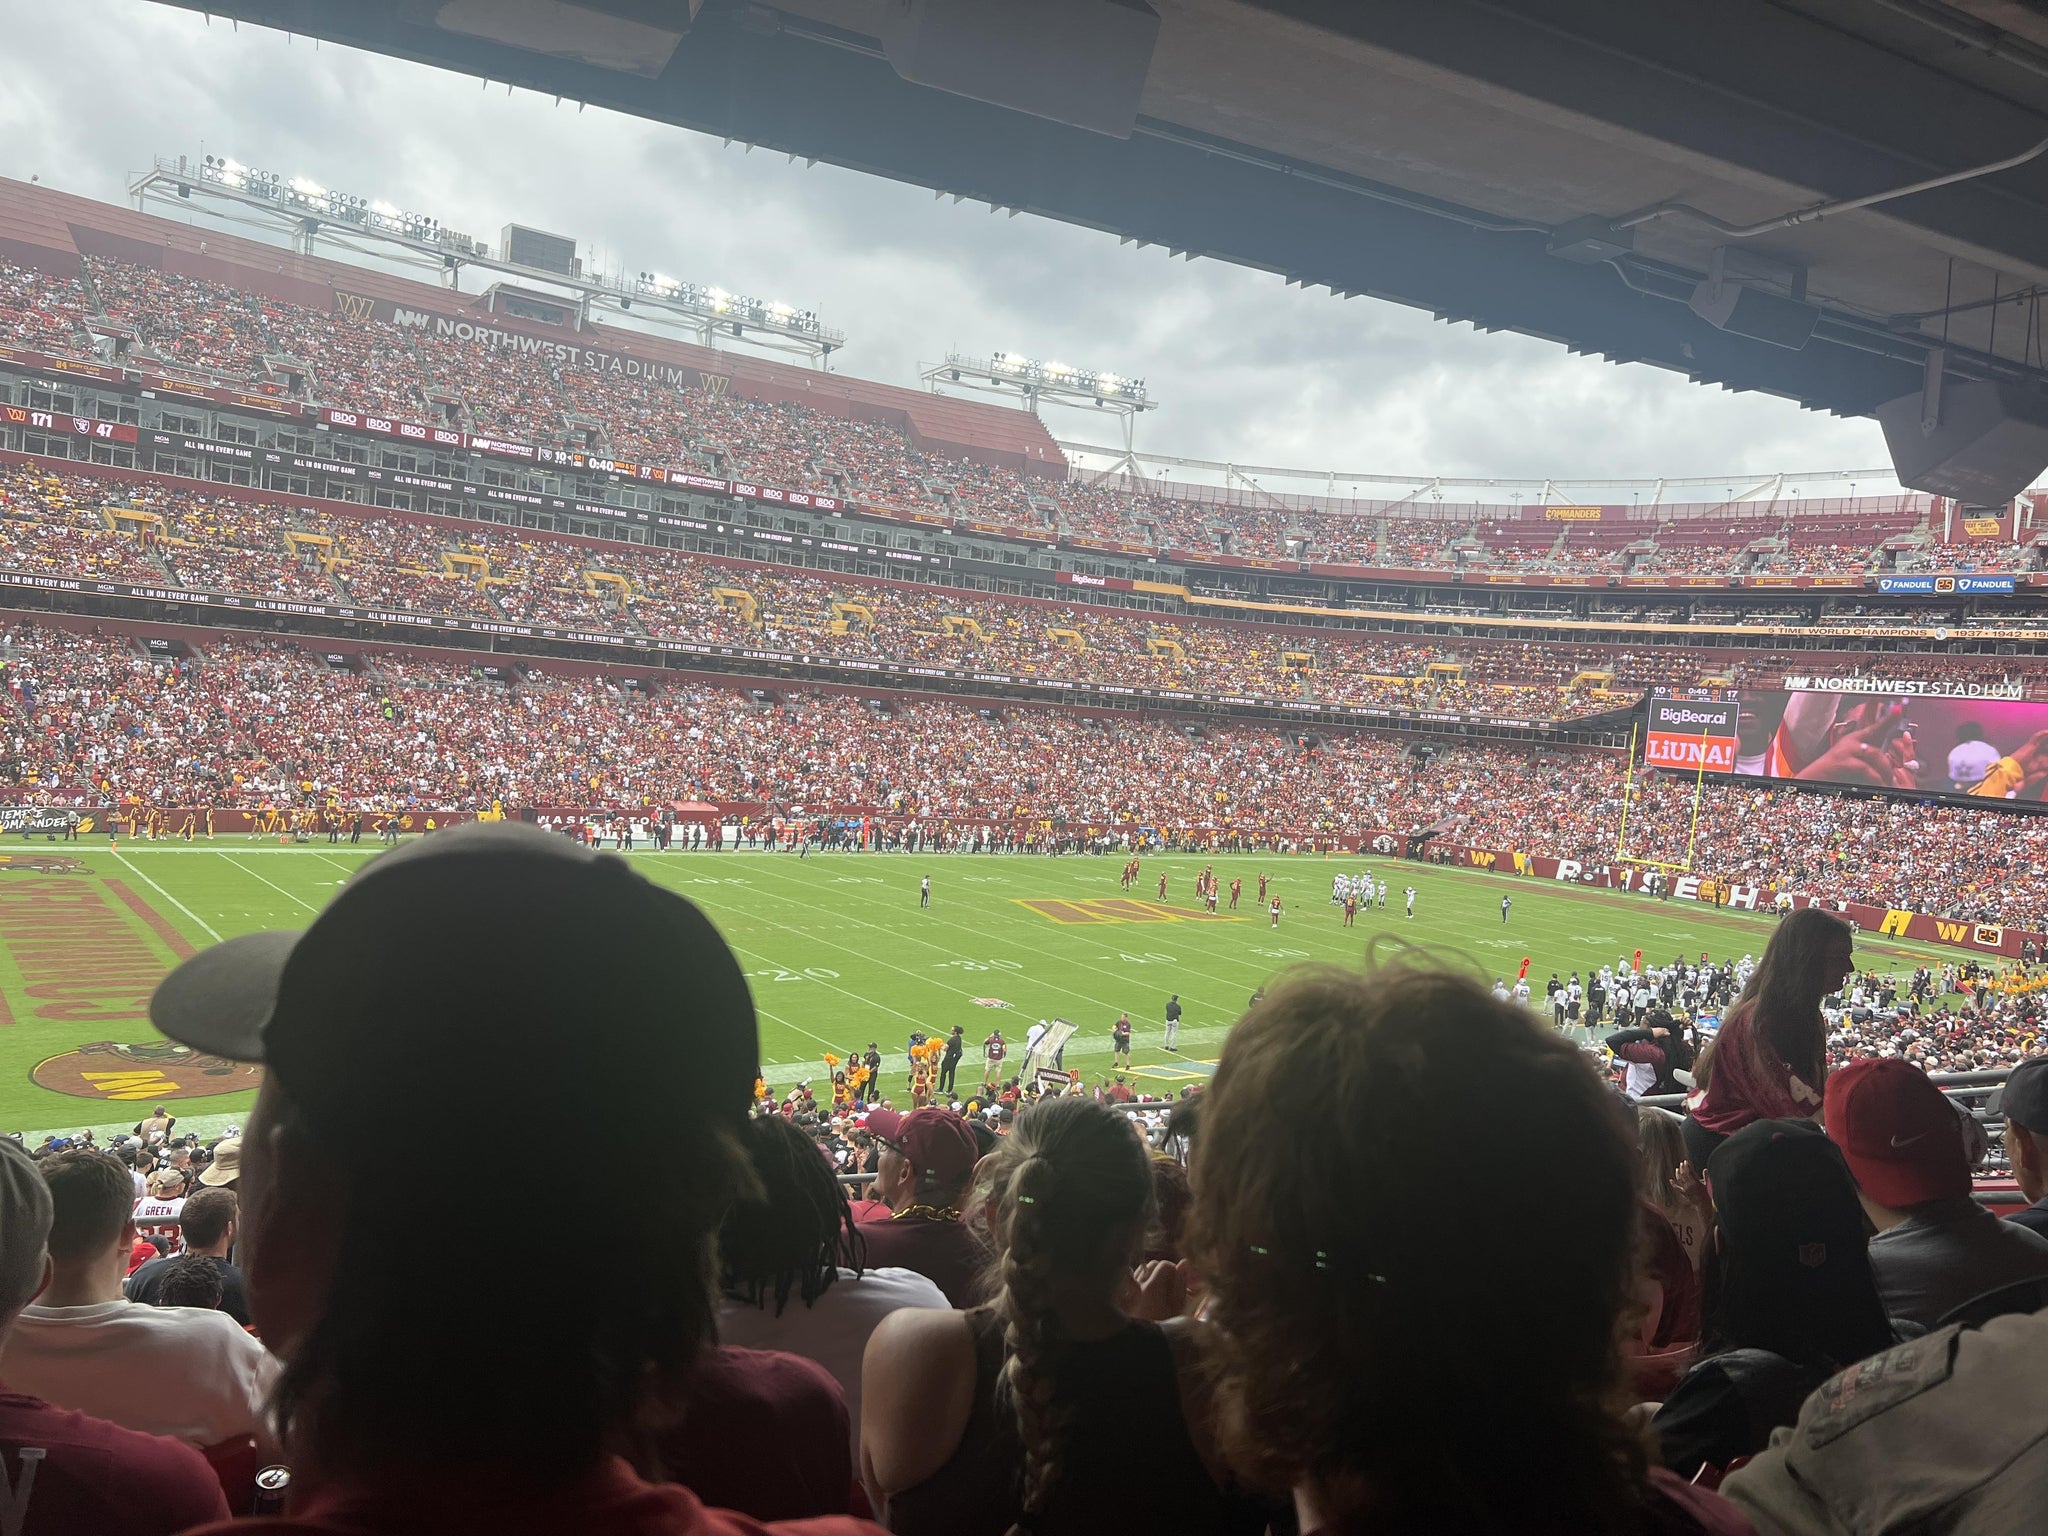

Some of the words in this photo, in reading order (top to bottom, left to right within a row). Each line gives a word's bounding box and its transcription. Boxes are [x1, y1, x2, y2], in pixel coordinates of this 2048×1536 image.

[437, 318, 580, 364] NORTHWEST
[585, 351, 682, 386] STADIUM
[31, 412, 52, 428] 171
[331, 411, 356, 425] BDO
[96, 423, 113, 438] 47
[367, 418, 391, 432] BDO
[401, 424, 425, 438] BDO
[435, 431, 458, 444] BDO
[185, 440, 196, 449] ALL
[216, 445, 234, 455] EVERY
[236, 449, 252, 458] GAME
[491, 440, 533, 453] NORTHWEST
[555, 452, 566, 460] 10
[323, 463, 339, 473] EVERY
[341, 466, 355, 475] GAME
[589, 458, 613, 472] 0:40
[642, 466, 651, 476] 17
[421, 479, 437, 488] EVERY
[438, 481, 452, 490] GAME
[688, 476, 726, 487] NORTHWEST
[737, 484, 756, 496] BDO
[763, 488, 783, 500] BDO
[513, 494, 528, 503] EVERY
[529, 496, 542, 504] GAME
[789, 493, 809, 505] BDO
[816, 497, 835, 508] BDO
[1546, 509, 1601, 519] COMMANDERS
[0, 573, 9, 583] LL
[12, 575, 20, 584] IN
[22, 576, 33, 585] ON
[35, 577, 57, 588] EVERY
[60, 580, 80, 590] GAME
[132, 588, 145, 597] ALL
[168, 591, 188, 601] EVERY
[191, 593, 209, 603] GAME
[255, 601, 266, 609] ALL
[288, 604, 306, 613] EVERY
[308, 605, 326, 615] GAME
[398, 615, 415, 623] EVERY
[499, 625, 516, 634] EVERY
[1814, 678, 1928, 694] NORTHWEST
[1931, 682, 2023, 698] STADIUM
[1660, 708, 1727, 724] BigBear.ai
[1648, 740, 1732, 765] LiUNA!
[1978, 928, 1997, 943] 25
[1120, 952, 1178, 964] 40
[950, 959, 1024, 972] 30
[757, 967, 840, 982] 20
[145, 1206, 172, 1216] GREEN
